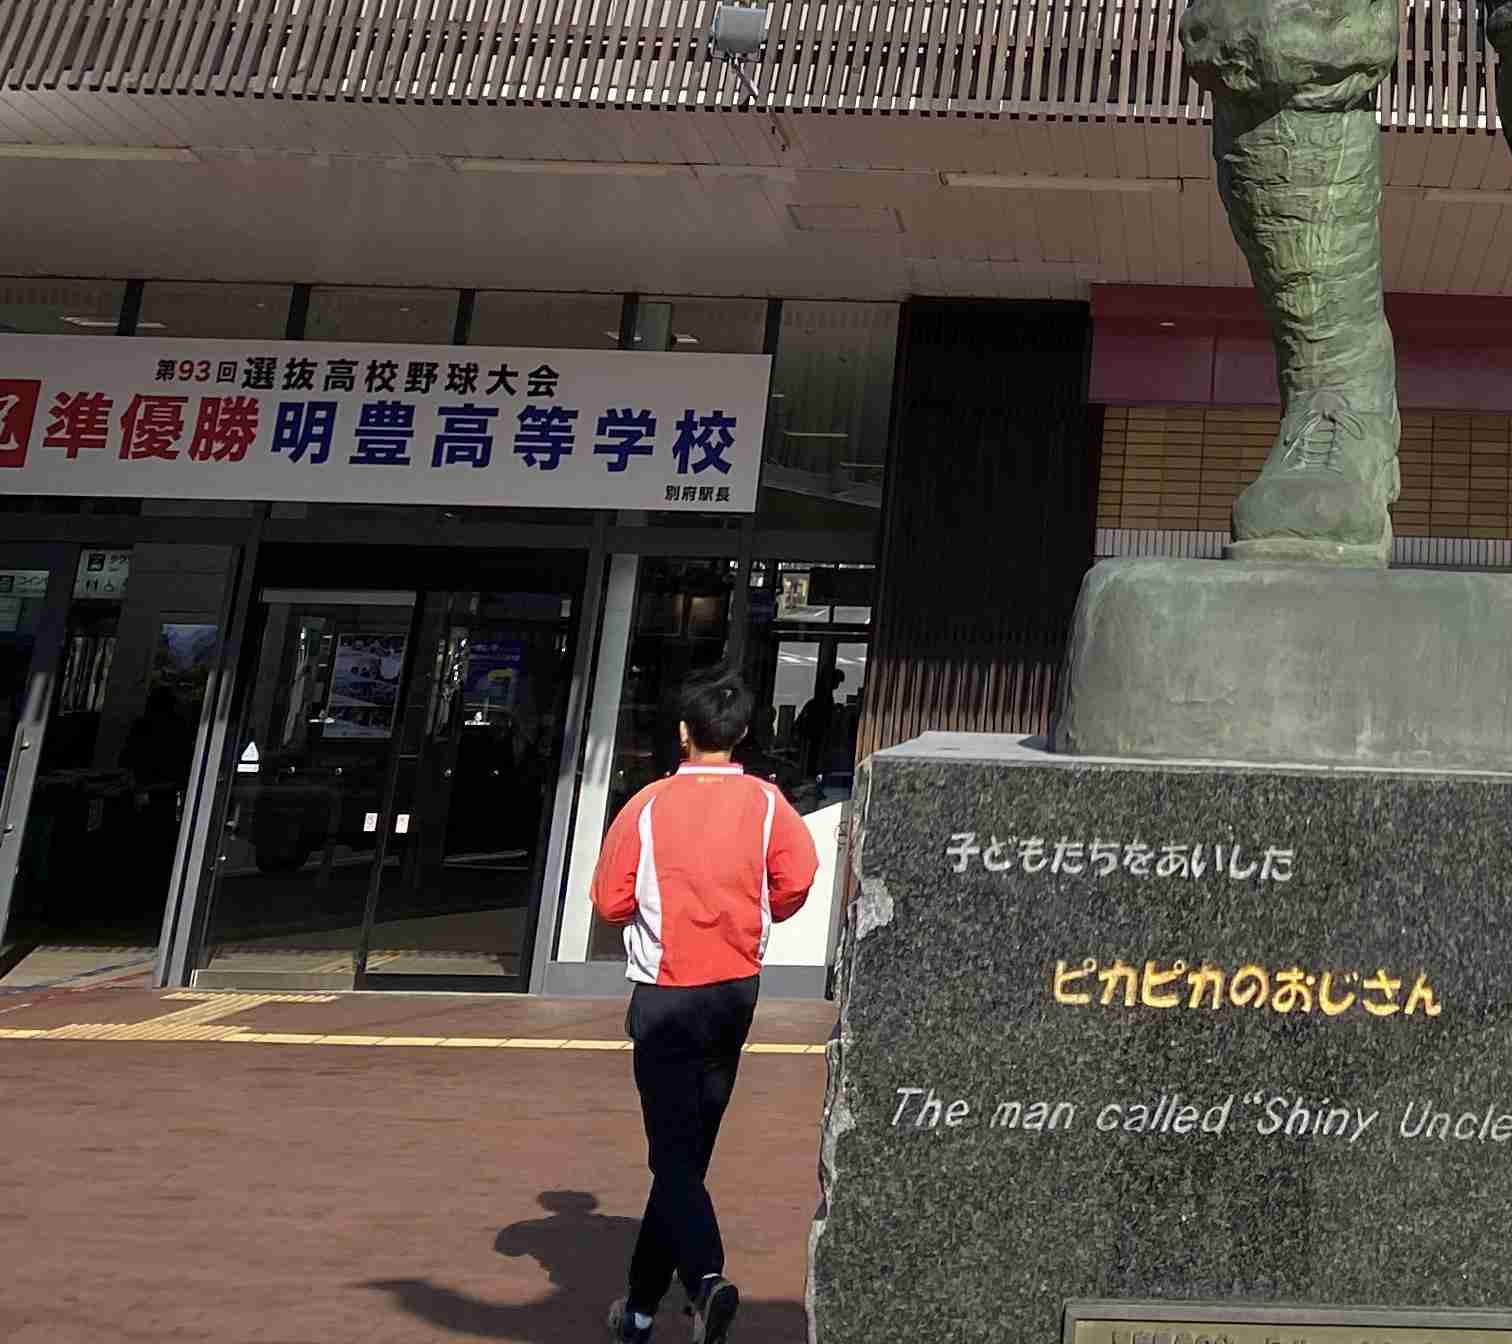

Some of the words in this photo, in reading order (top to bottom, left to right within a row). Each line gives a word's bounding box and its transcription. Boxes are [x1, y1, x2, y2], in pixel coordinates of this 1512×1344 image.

[43, 392, 260, 463] 準優勝
[271, 399, 738, 475] 明豊高等学校
[665, 485, 731, 503] 別府駅長
[946, 831, 1295, 881] 子どもたちをあいした
[1053, 958, 1442, 1016] ピカピカのおじさん
[890, 1087, 970, 1127] The
[990, 1097, 1074, 1131] man
[1096, 1093, 1234, 1134] called
